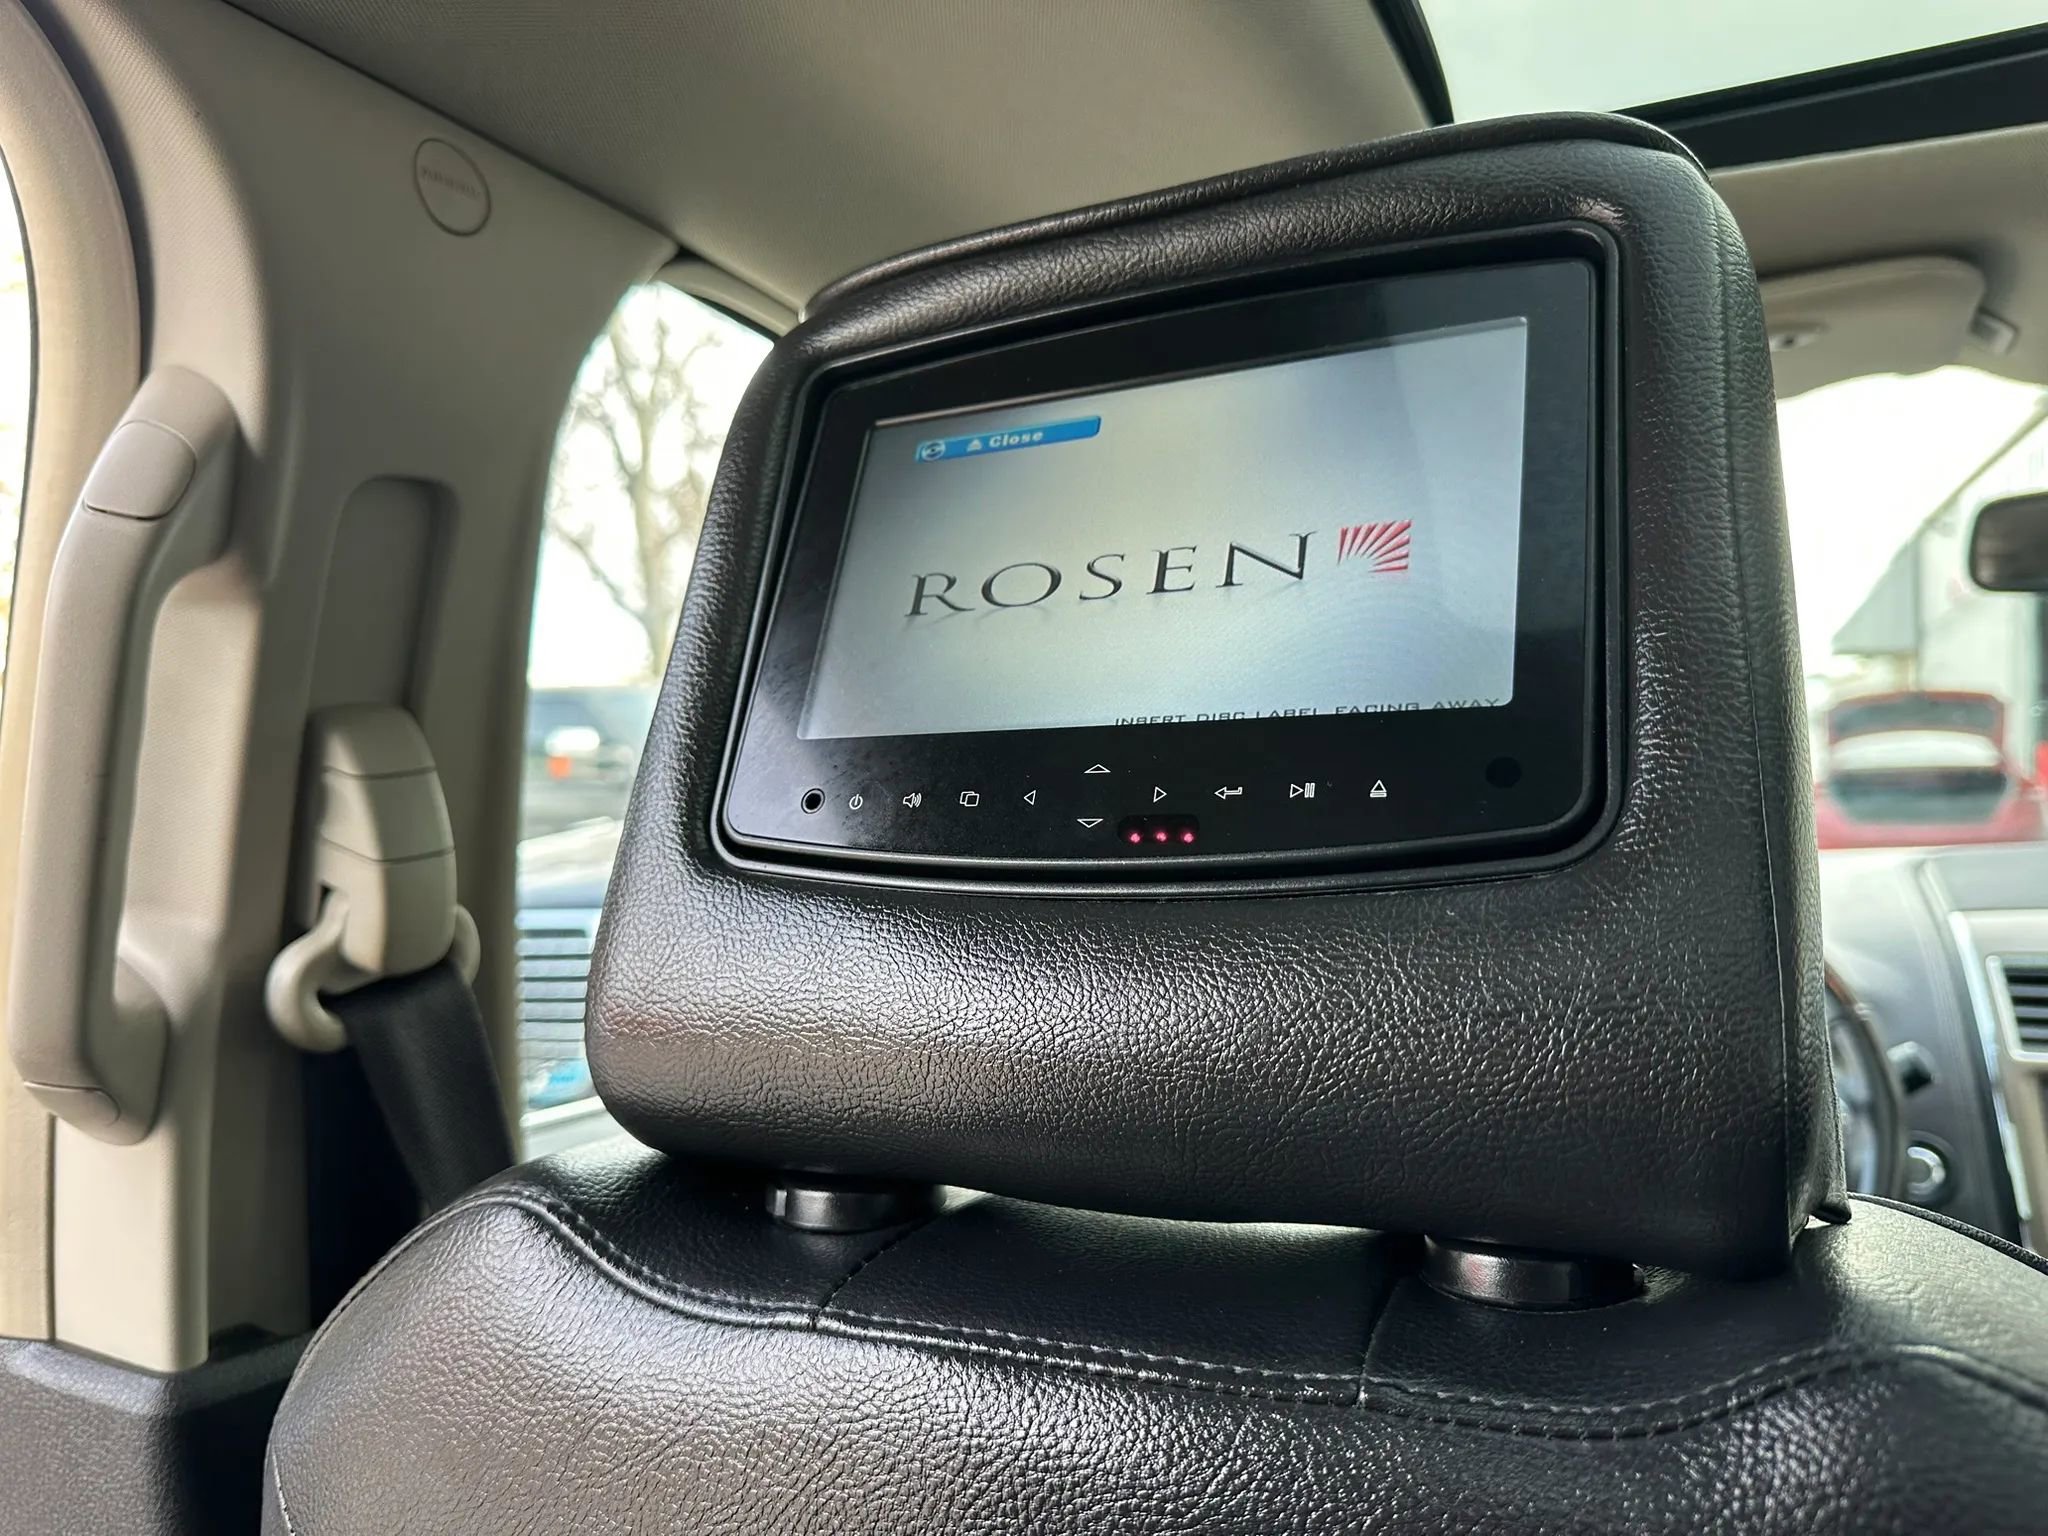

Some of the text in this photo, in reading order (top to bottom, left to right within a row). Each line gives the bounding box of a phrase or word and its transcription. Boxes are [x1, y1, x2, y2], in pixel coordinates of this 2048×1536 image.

[988, 431, 1044, 448] Close
[904, 530, 1318, 617] ROSEN
[1433, 698, 1499, 710] AWAY
